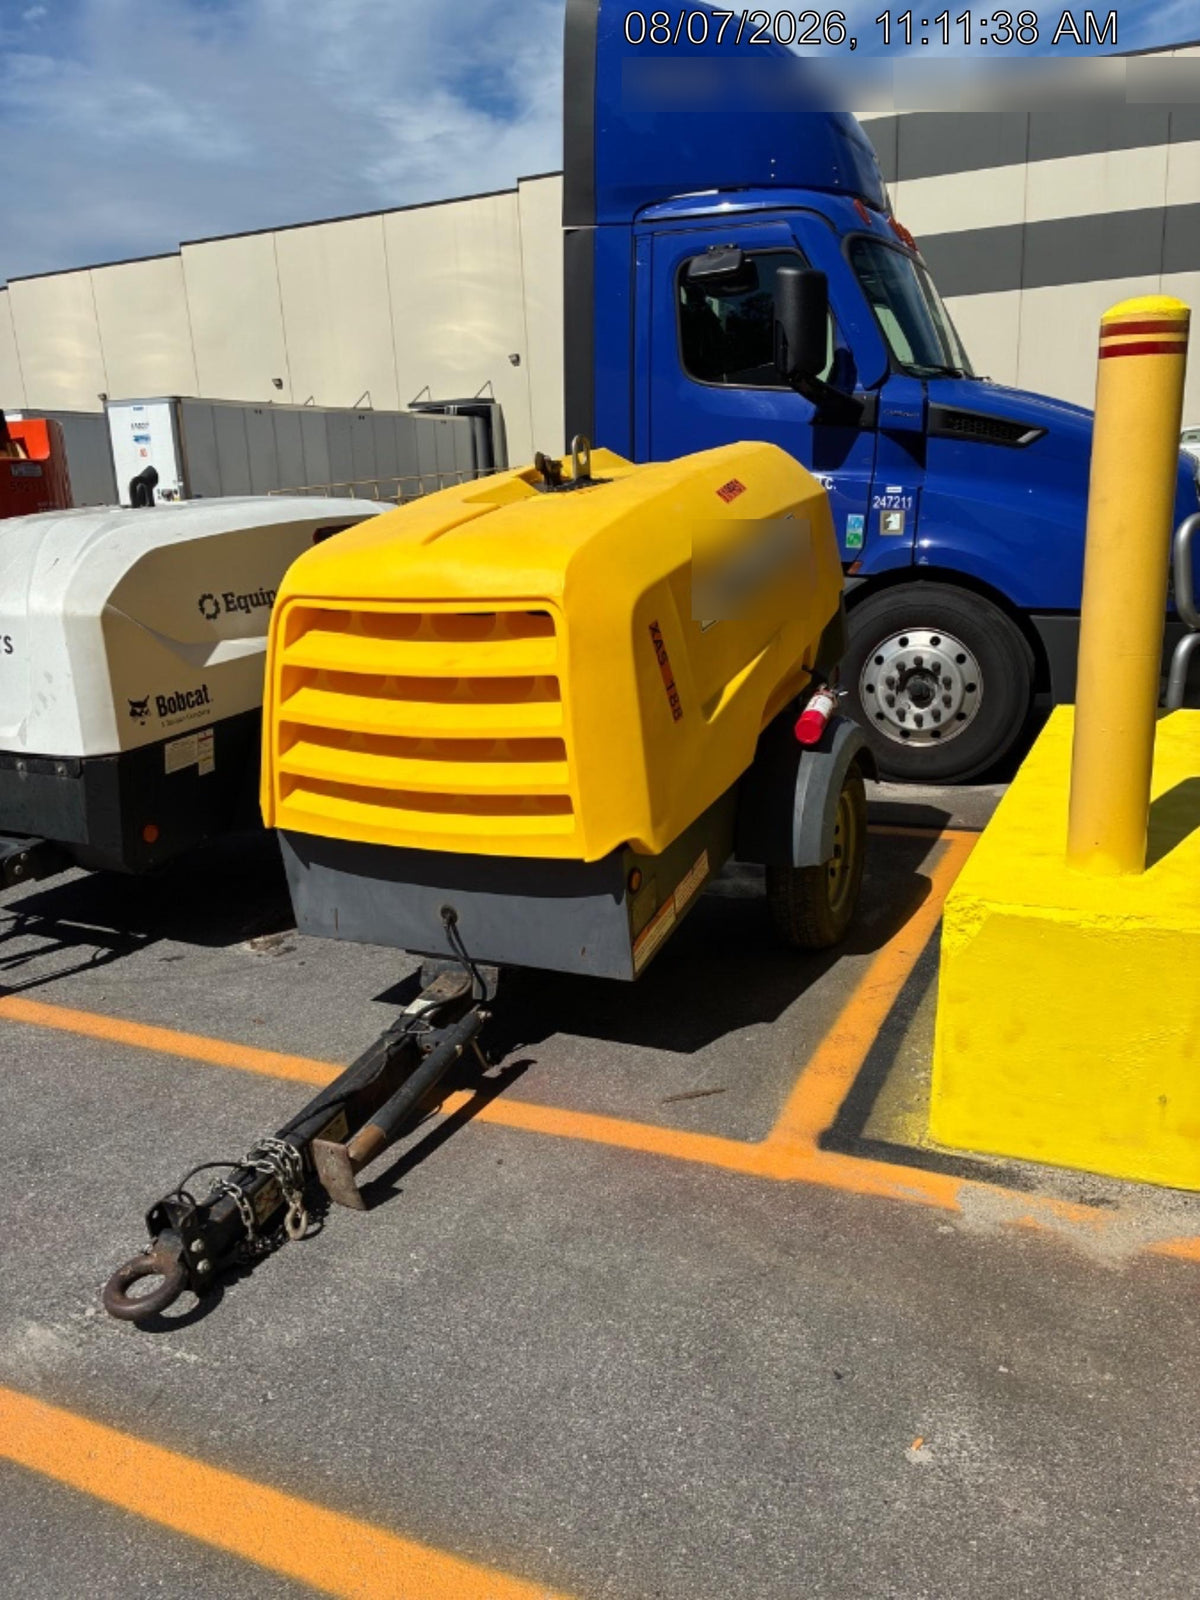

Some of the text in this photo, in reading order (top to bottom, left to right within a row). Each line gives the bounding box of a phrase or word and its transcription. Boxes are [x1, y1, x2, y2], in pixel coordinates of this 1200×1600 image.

[872, 495, 913, 510] 247211
[221, 588, 277, 615] Equip
[0, 635, 14, 655] S
[648, 619, 668, 667] XAS
[155, 684, 211, 717] Bobcat
